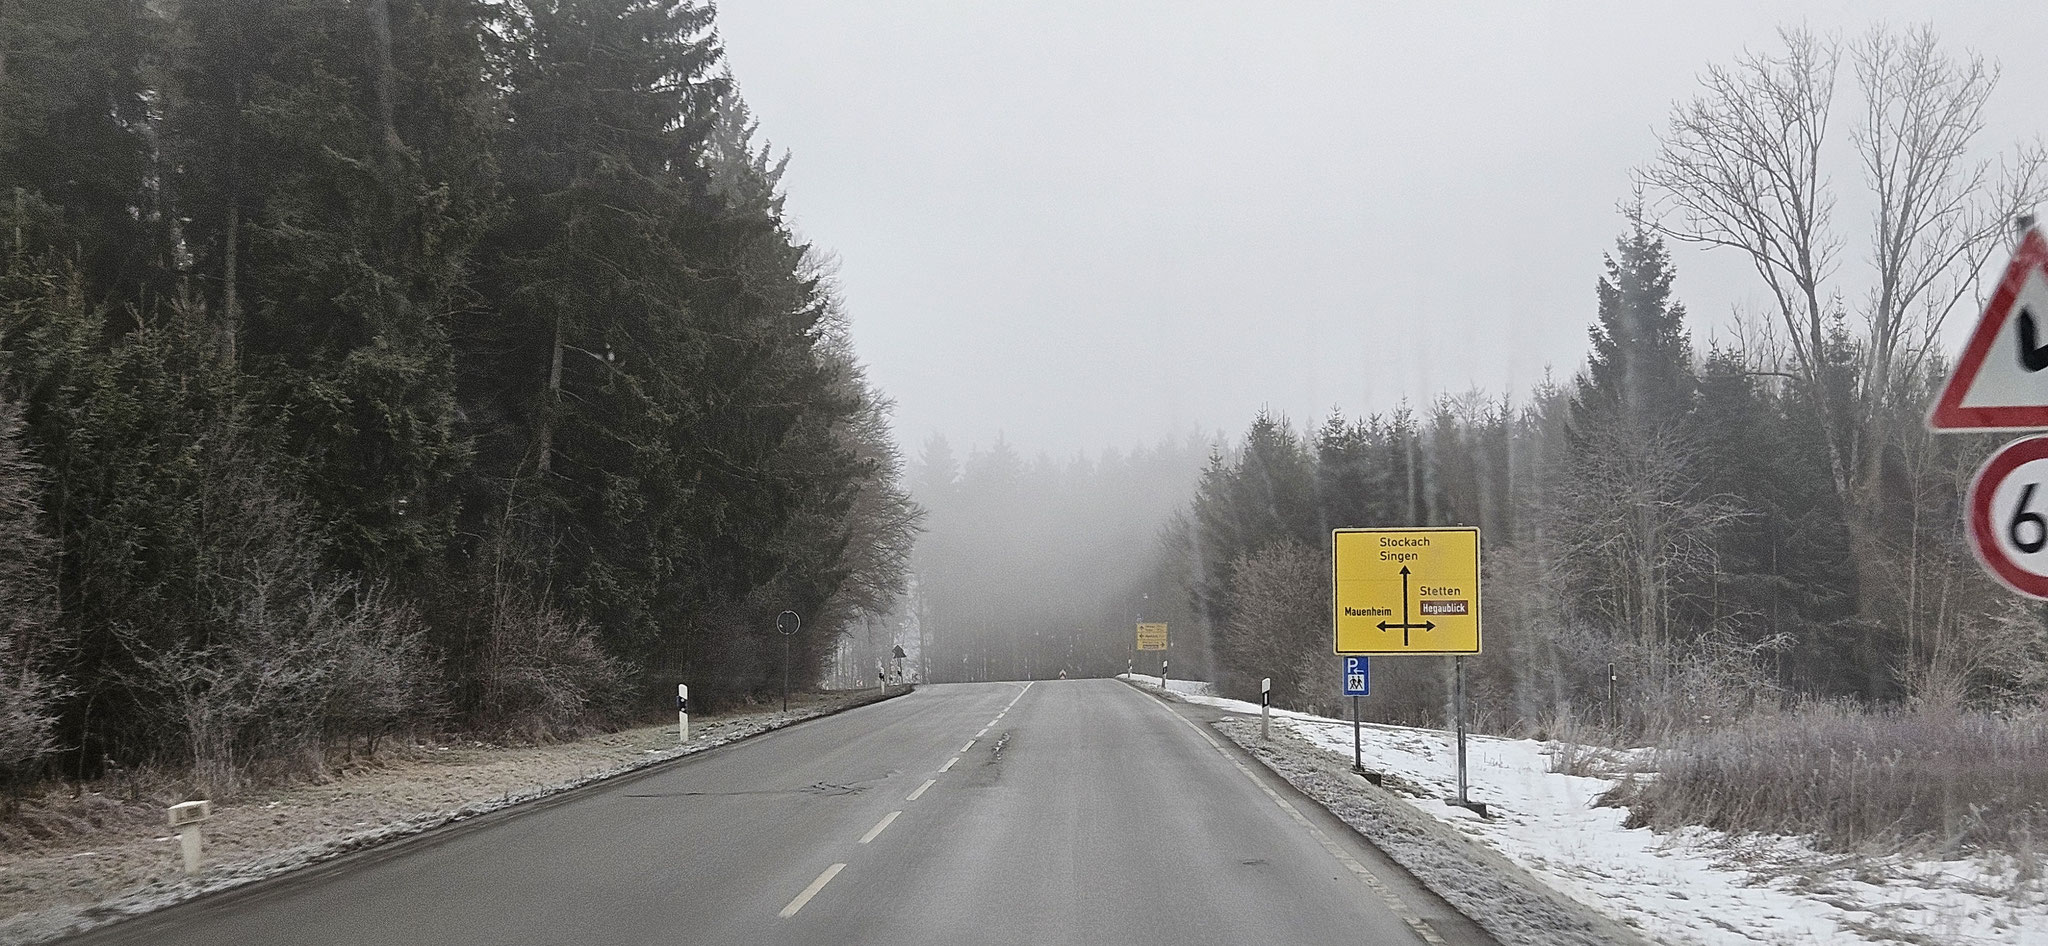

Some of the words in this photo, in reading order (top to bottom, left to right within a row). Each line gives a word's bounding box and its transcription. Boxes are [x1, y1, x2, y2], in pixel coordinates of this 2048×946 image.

[1380, 537, 1430, 547] Stockach
[1380, 551, 1418, 563] Singen
[1420, 586, 1461, 596] Stetten
[1345, 606, 1392, 616] Mauenheim
[1423, 603, 1465, 614] Hegaublick
[1347, 657, 1359, 674] P
